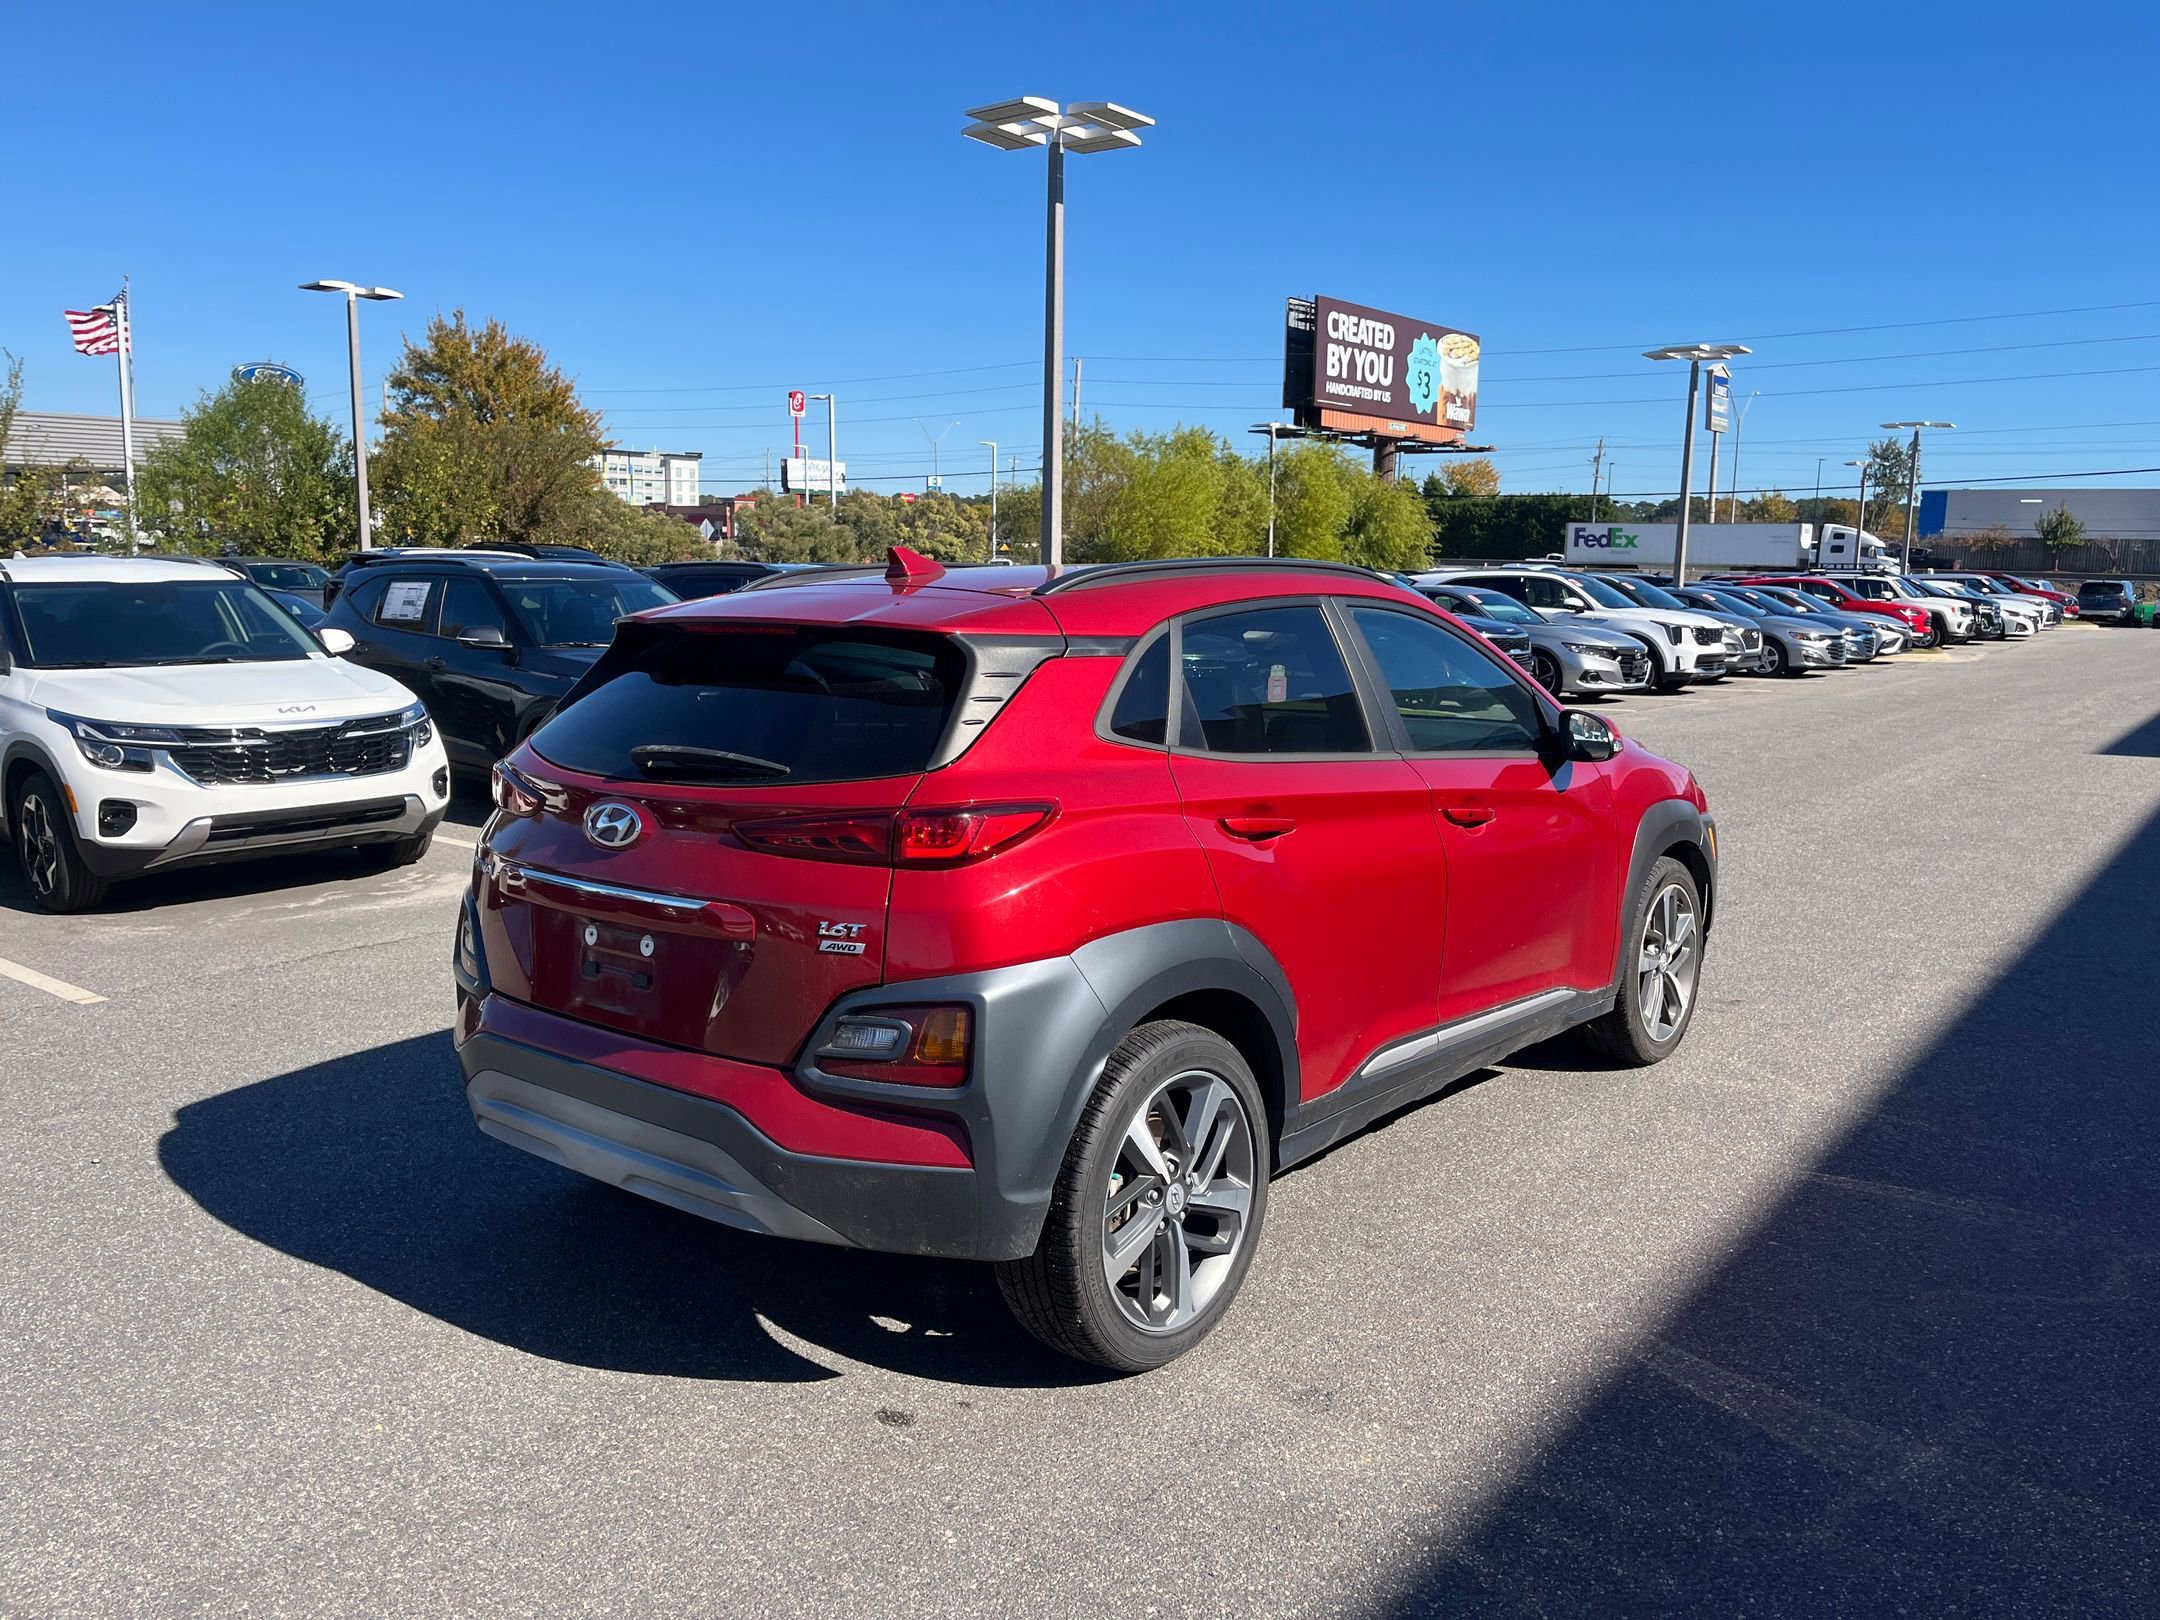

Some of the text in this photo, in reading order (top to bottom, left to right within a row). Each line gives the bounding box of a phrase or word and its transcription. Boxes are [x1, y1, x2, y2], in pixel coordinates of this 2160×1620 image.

[1327, 311, 1395, 350] CREATED
[1326, 343, 1394, 386] BY YOU
[1325, 381, 1391, 403] HANDCRAFTED BY US
[1417, 370, 1431, 399] $3
[1573, 527, 1639, 548] FedEx
[278, 705, 316, 714] KIA
[825, 943, 857, 952] AWD
